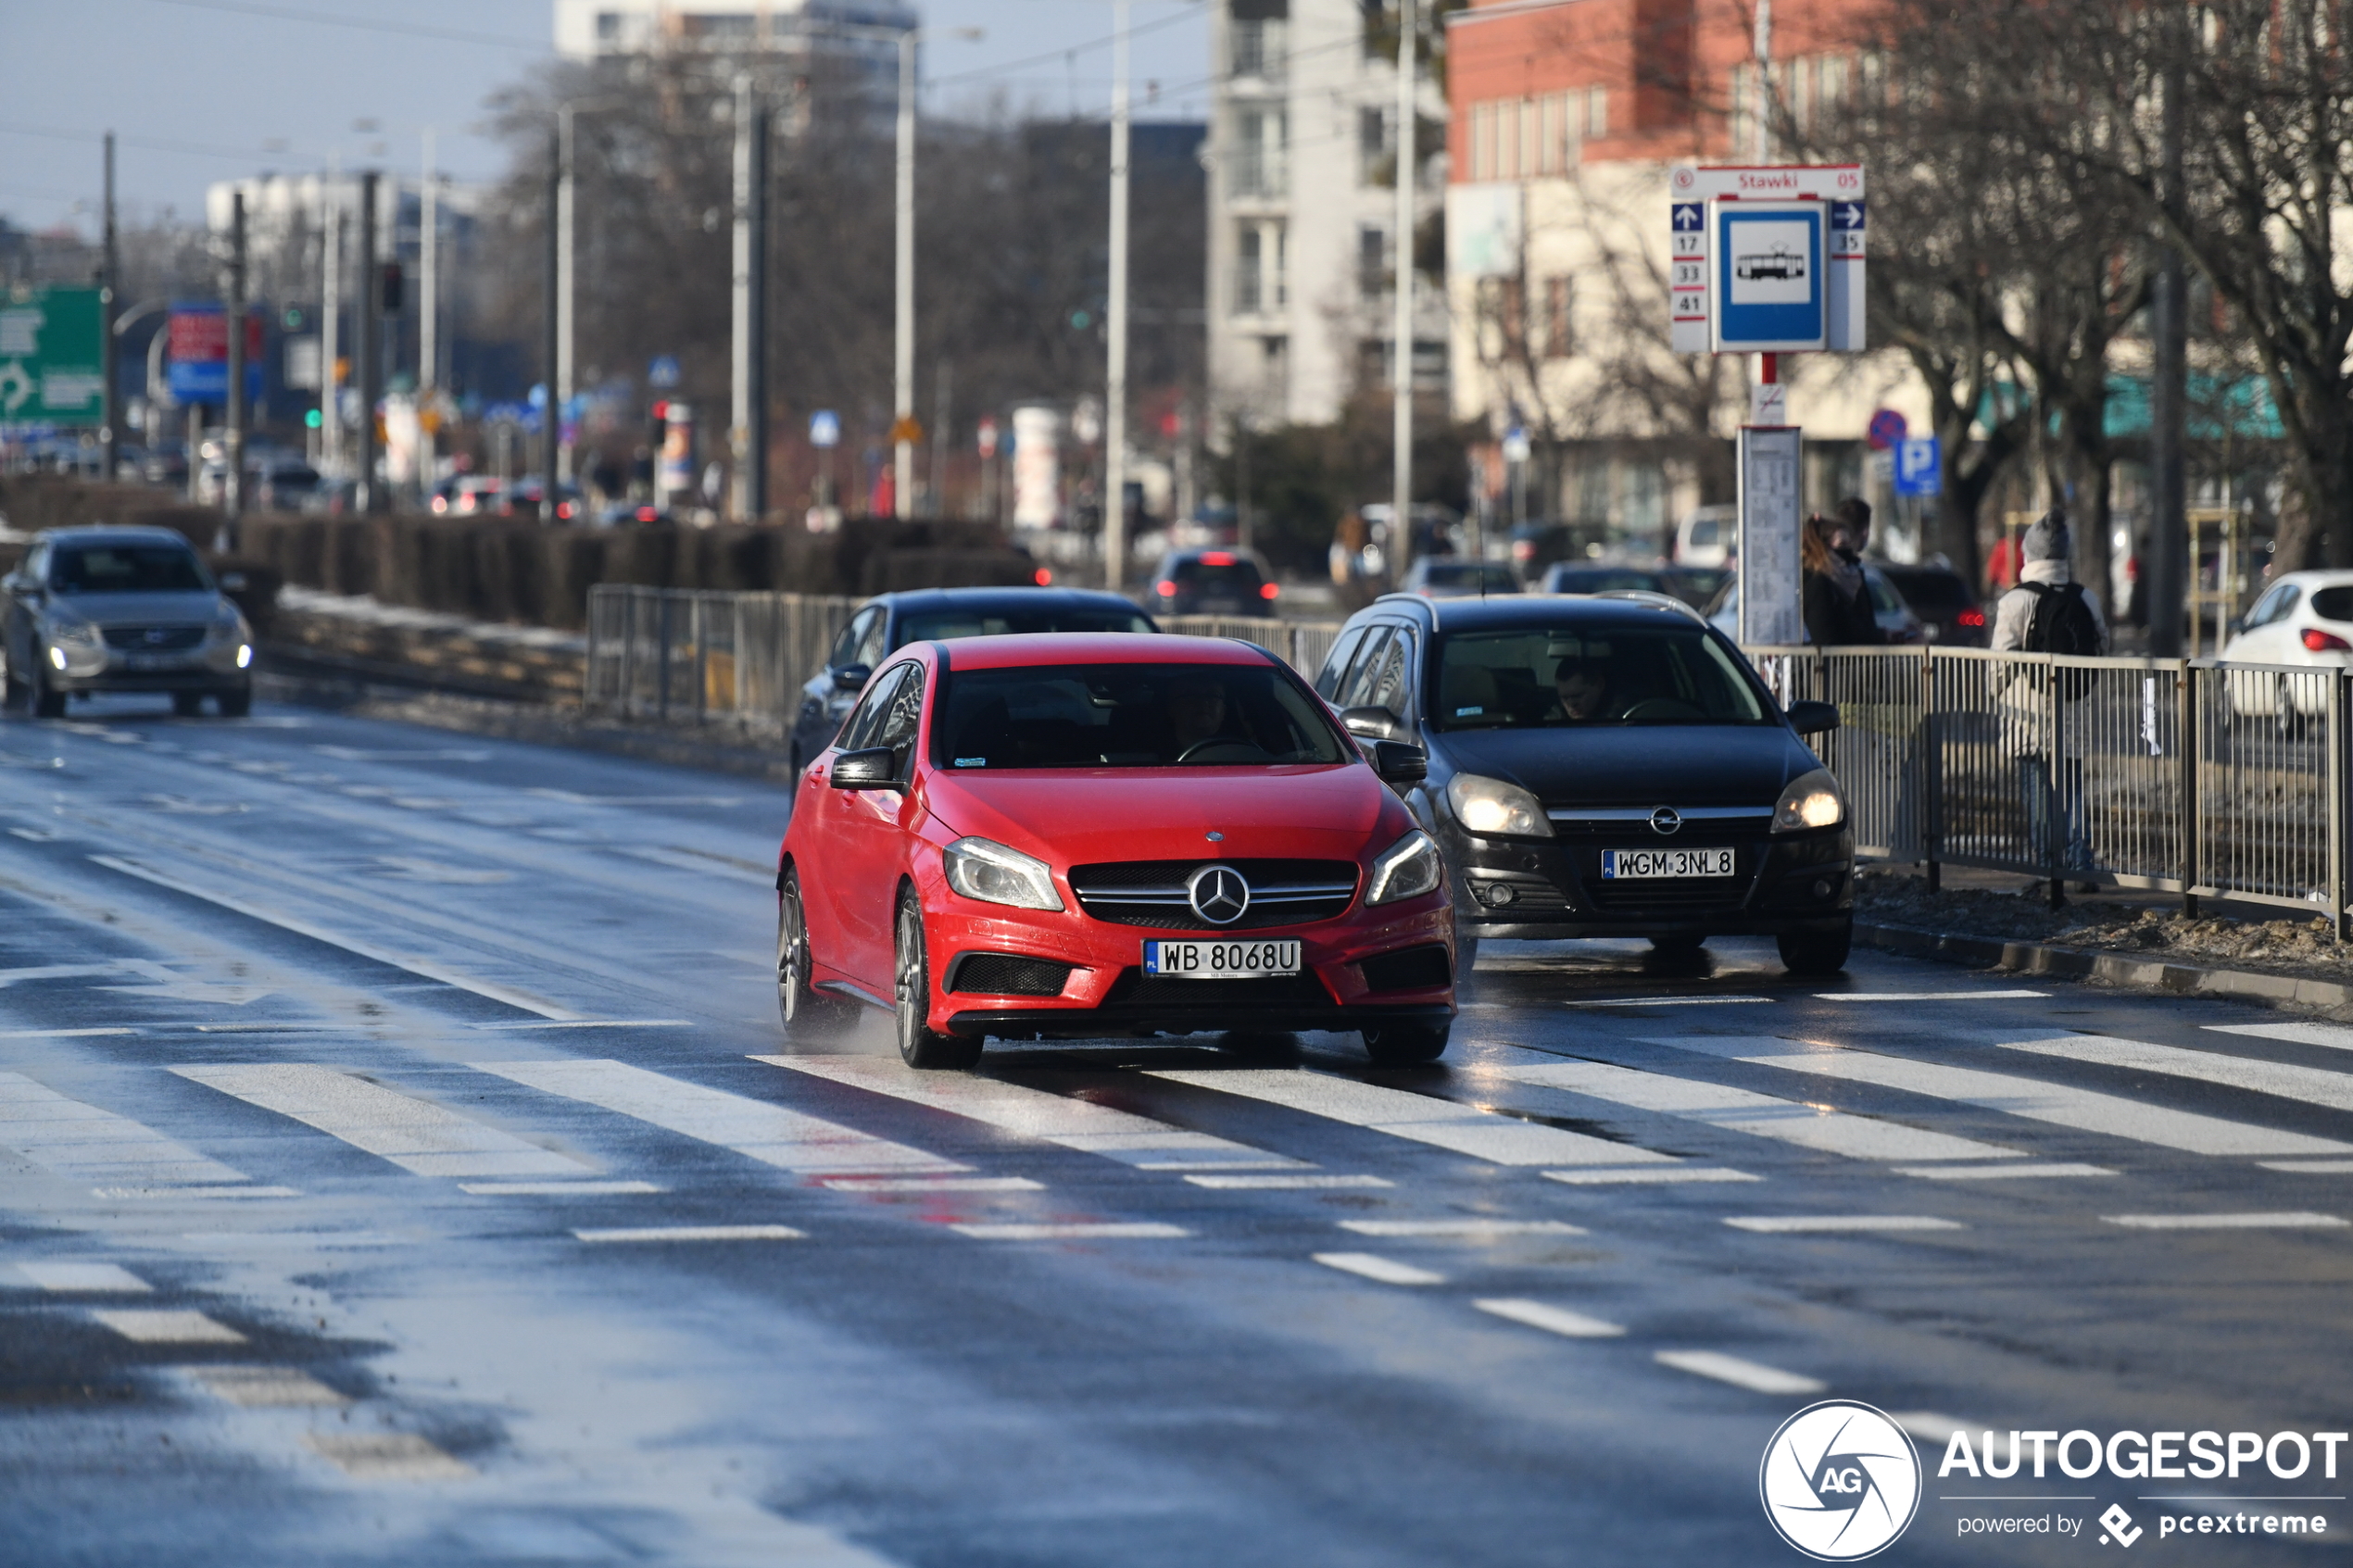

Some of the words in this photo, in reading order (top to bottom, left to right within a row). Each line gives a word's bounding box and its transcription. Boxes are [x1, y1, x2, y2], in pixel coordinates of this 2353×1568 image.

[1739, 171, 1799, 188] Stawki
[1837, 173, 1858, 188] 05
[1678, 237, 1698, 252] 17
[1838, 235, 1858, 251] 35
[1679, 266, 1699, 282] 33
[1679, 296, 1699, 311] 41
[1901, 441, 1933, 482] P
[1618, 852, 1667, 875] WGM
[1675, 851, 1730, 874] 3NL8
[1147, 960, 1157, 969] PL
[1164, 944, 1199, 971] WB
[1210, 943, 1295, 971] 8068U
